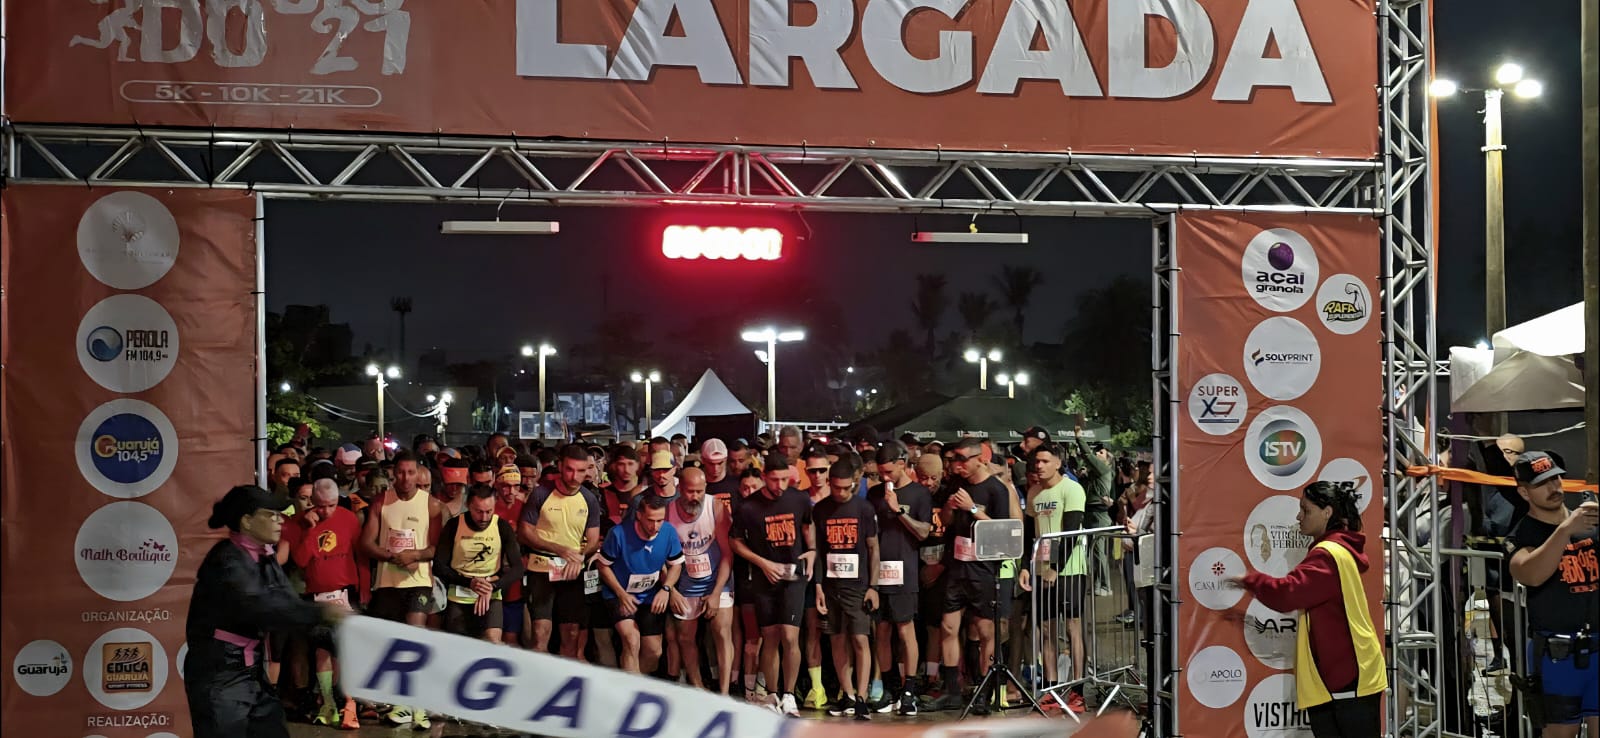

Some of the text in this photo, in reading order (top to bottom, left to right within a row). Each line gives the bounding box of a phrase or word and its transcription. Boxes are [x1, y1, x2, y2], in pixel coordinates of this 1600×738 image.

[514, 0, 1334, 104] LARGADA
[155, 84, 193, 99] 5K
[219, 85, 272, 101] 10K
[297, 87, 347, 104] 21K
[1256, 284, 1304, 294] granola
[1324, 300, 1357, 313] RAFA
[126, 350, 137, 361] FM
[140, 350, 161, 363] 104,9
[1265, 353, 1313, 361] SOLYPRINT
[1198, 385, 1239, 396] SUPER
[1264, 441, 1302, 457] ISTV
[1035, 501, 1058, 512] TIME
[80, 548, 171, 564] Nath Boutique
[81, 608, 173, 623] ORGANIZAÇÃO:
[107, 661, 149, 673] EDUCA
[1210, 669, 1242, 679] APOLO
[87, 713, 170, 729] REALIZAÇÃO:
